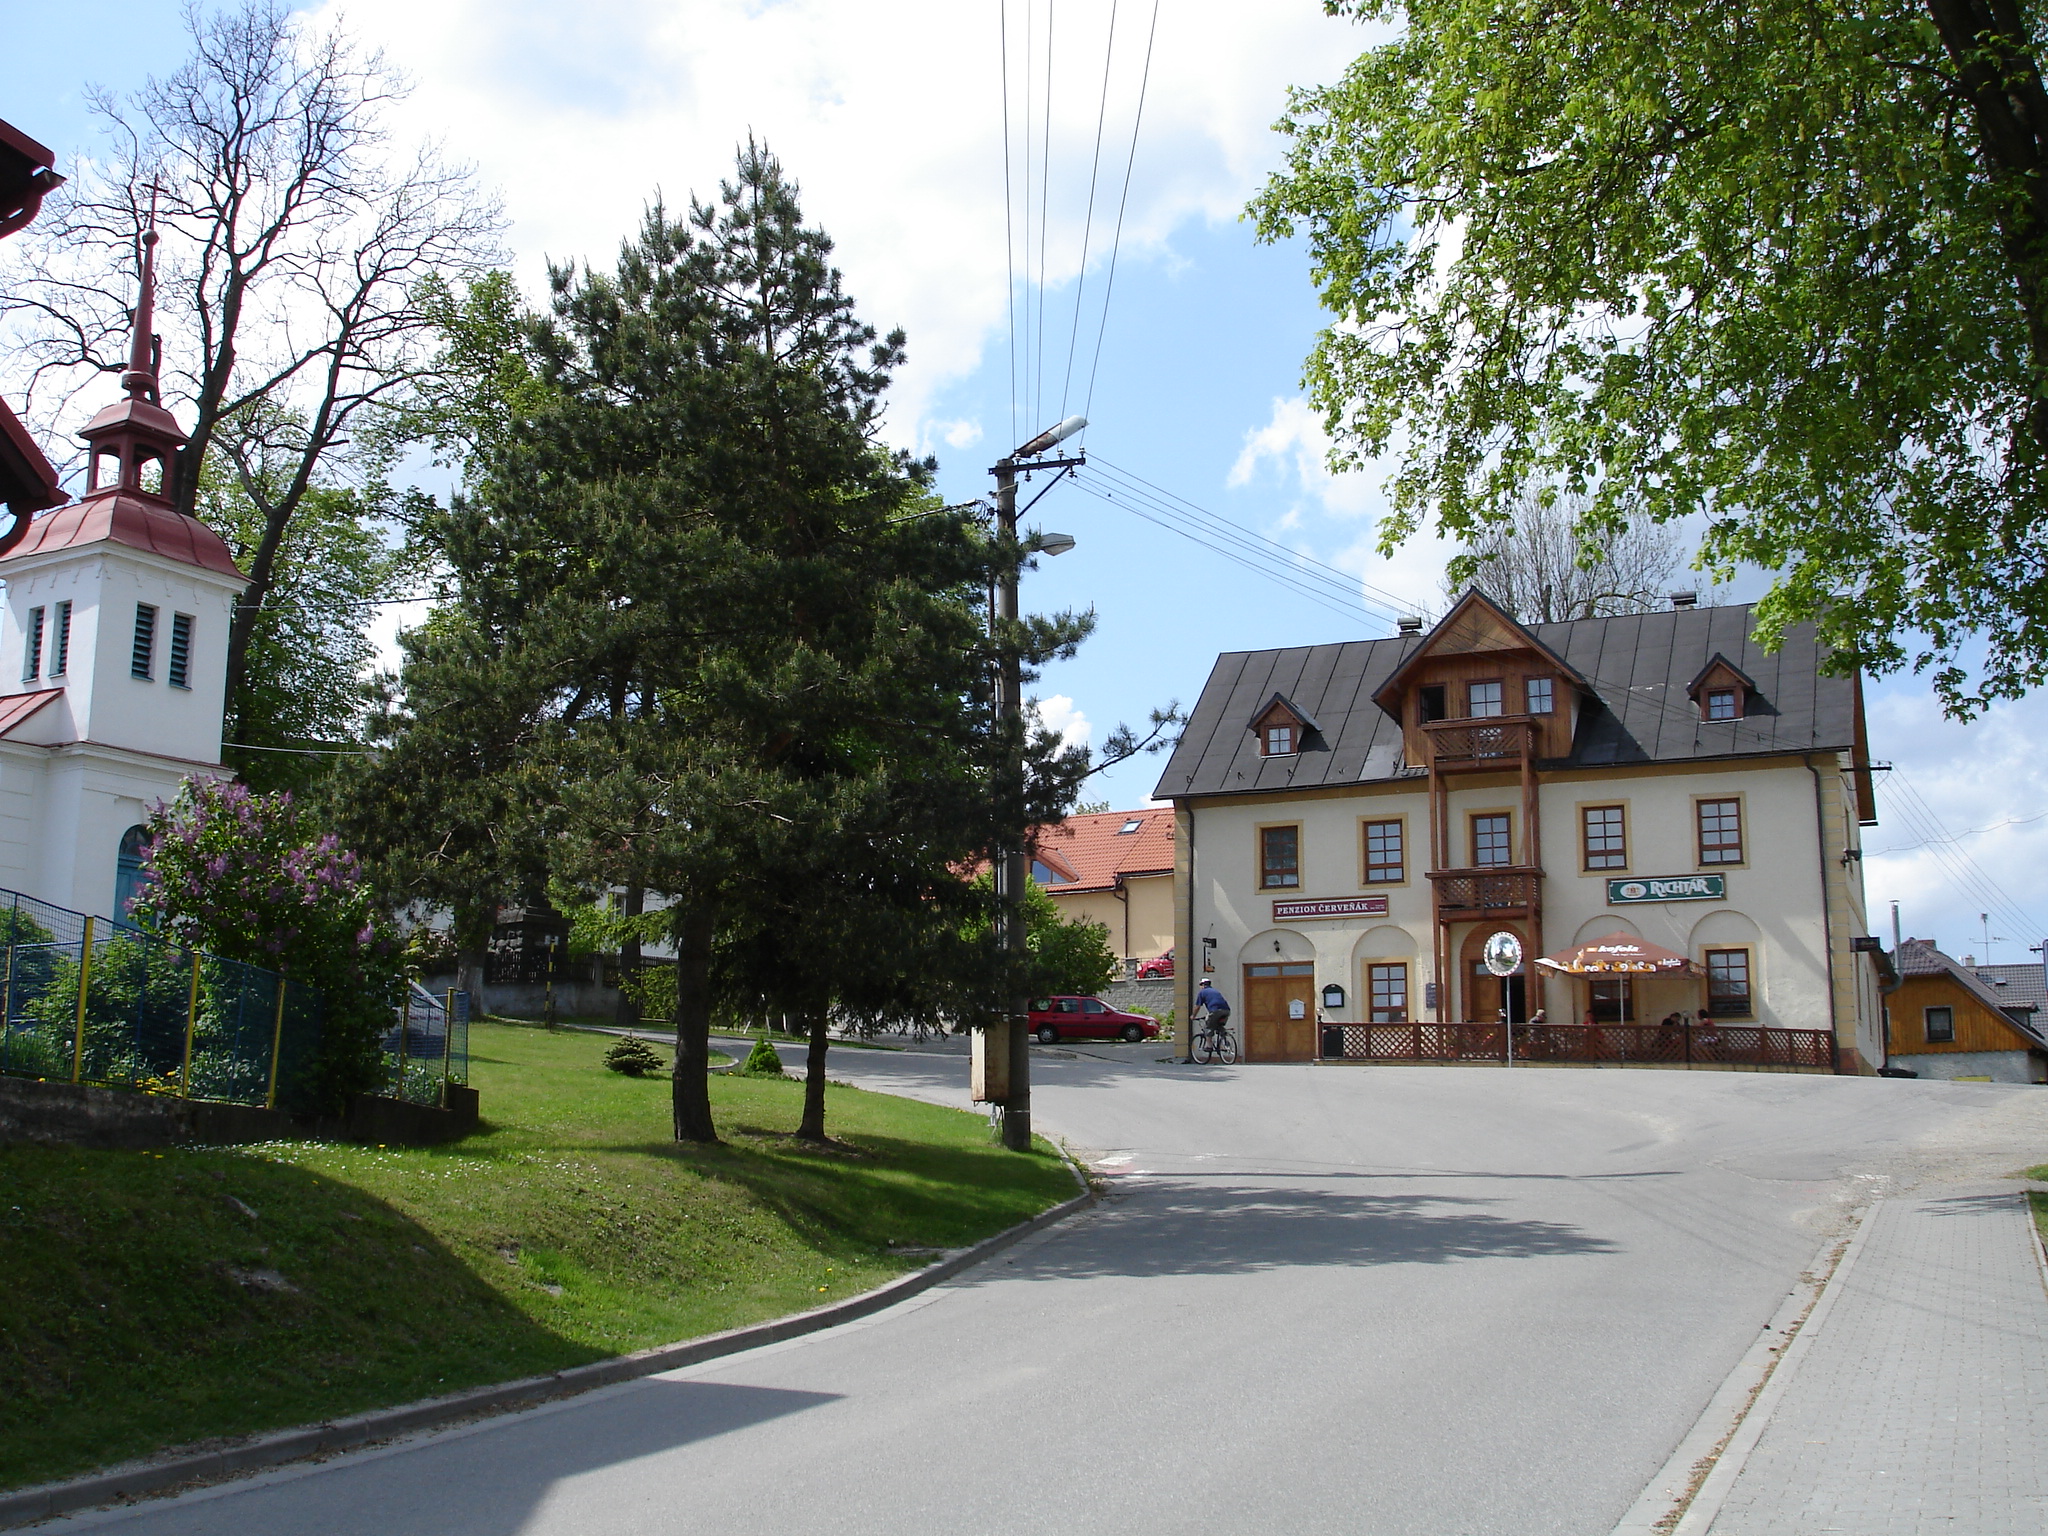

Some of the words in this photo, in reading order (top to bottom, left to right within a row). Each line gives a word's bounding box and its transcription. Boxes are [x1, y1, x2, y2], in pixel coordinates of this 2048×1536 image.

[1277, 906, 1316, 914] PENZION
[1318, 902, 1368, 912] ČERVEŇÁK
[1597, 945, 1640, 953] kofola
